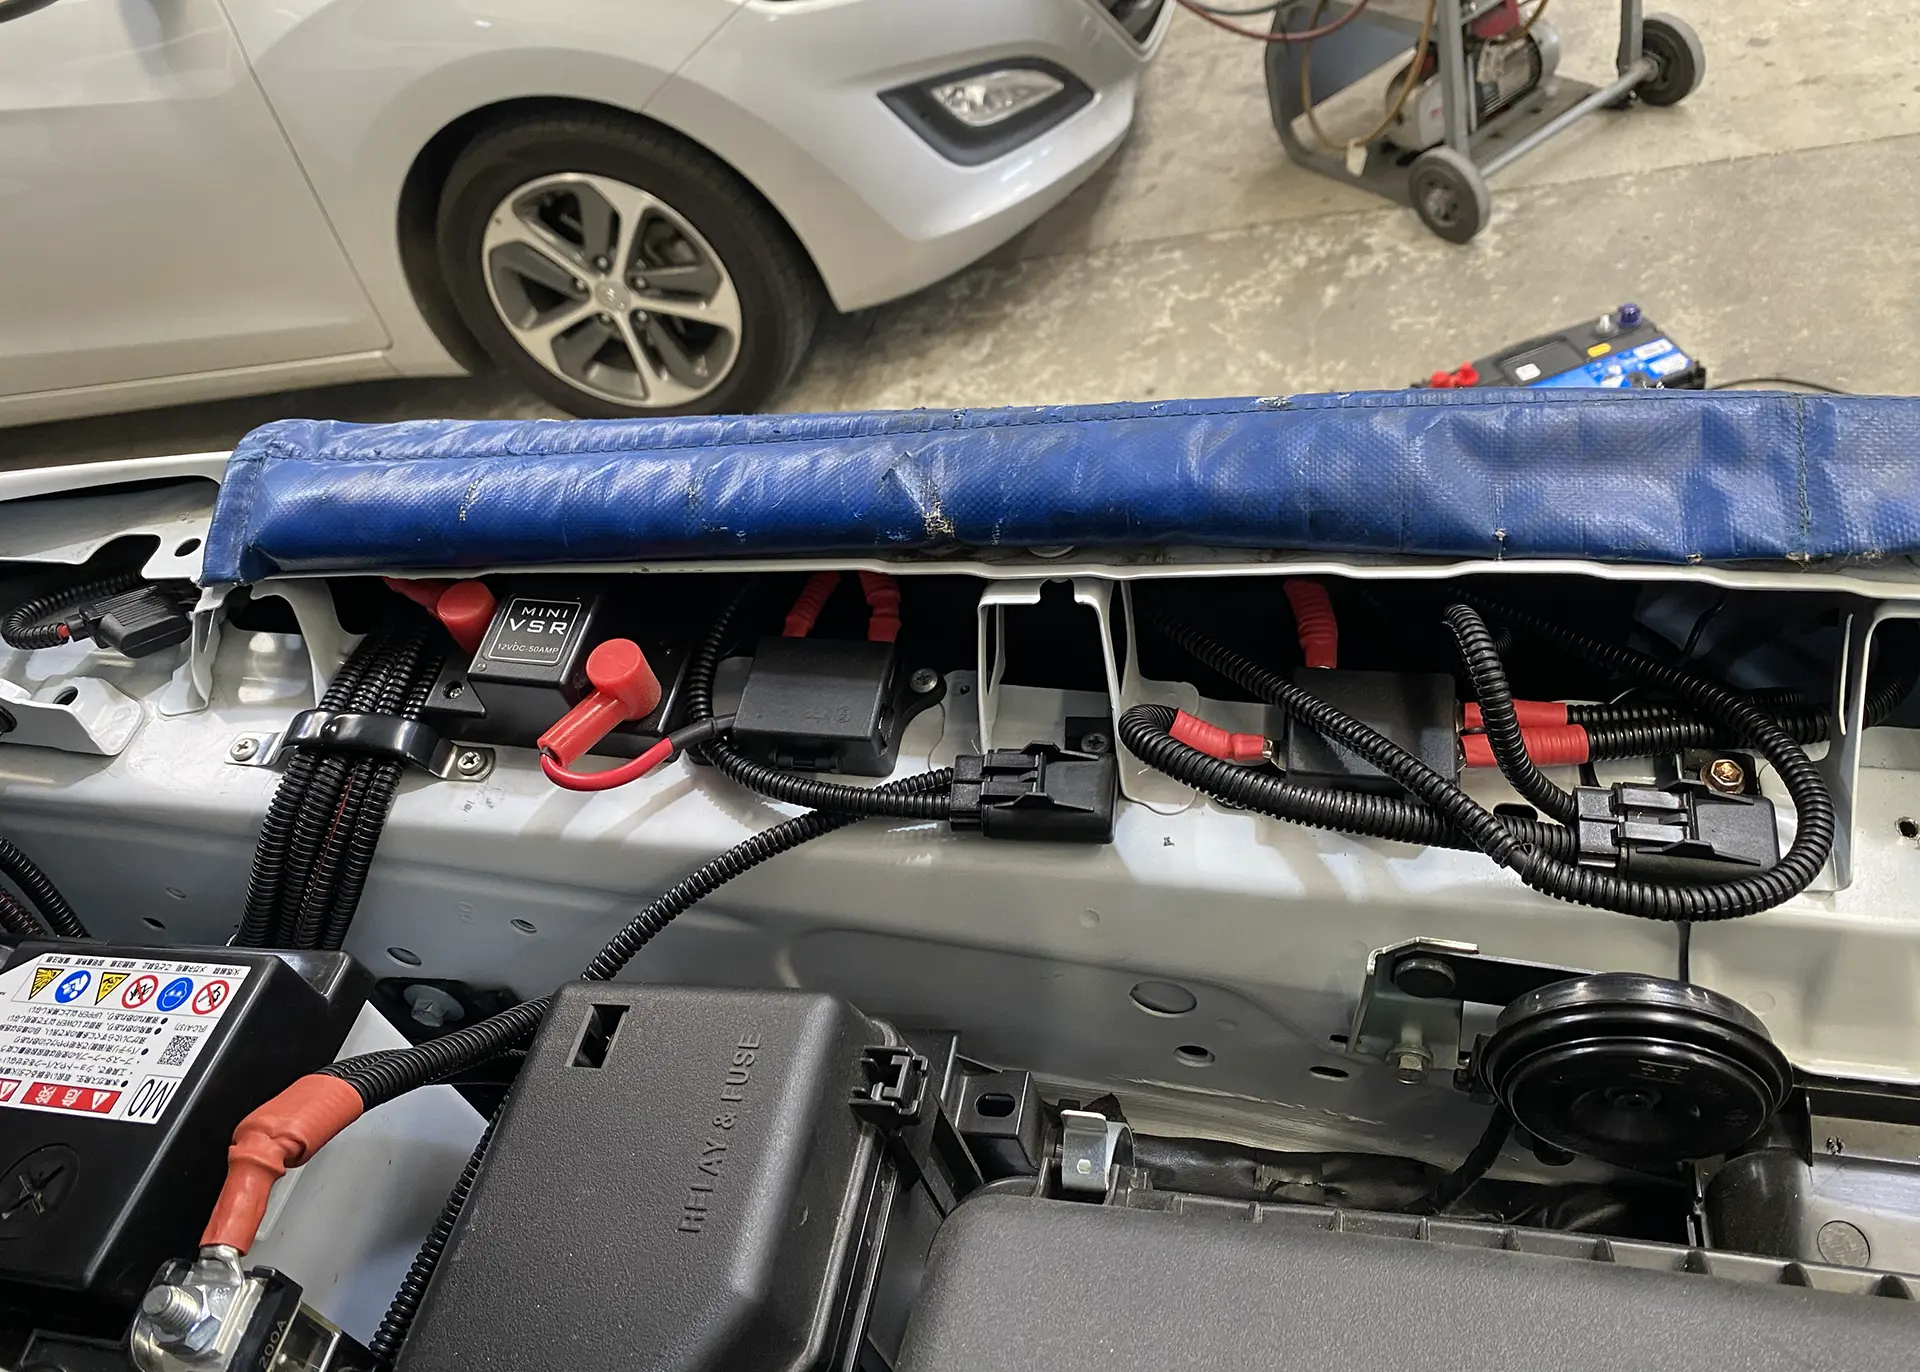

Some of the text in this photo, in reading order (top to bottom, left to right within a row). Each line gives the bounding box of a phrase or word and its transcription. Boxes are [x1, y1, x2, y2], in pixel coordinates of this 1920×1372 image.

[521, 606, 569, 619] MINI
[509, 618, 568, 635] VSR
[497, 643, 559, 654] 12VDC-50AMP
[34, 1086, 83, 1106] 危険
[678, 1033, 761, 1233] RELAY & FUSE
[258, 1320, 288, 1370] 200A
